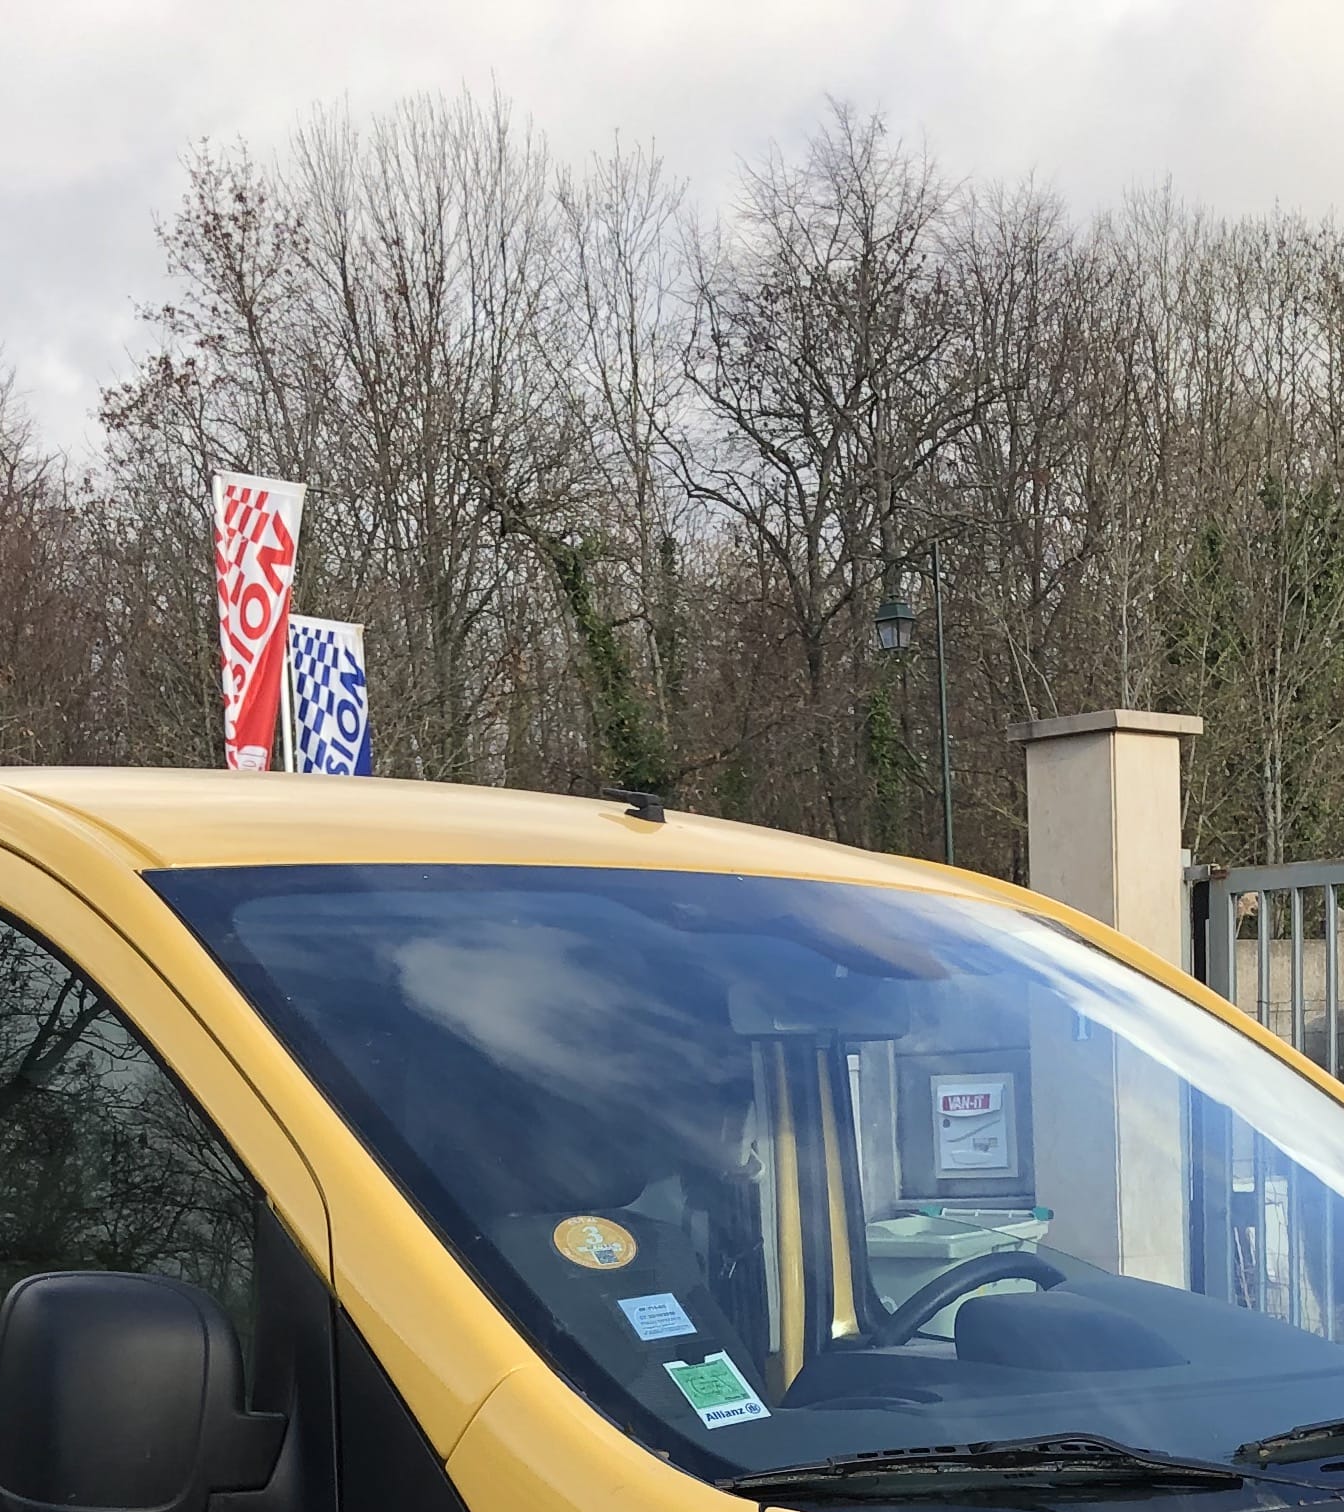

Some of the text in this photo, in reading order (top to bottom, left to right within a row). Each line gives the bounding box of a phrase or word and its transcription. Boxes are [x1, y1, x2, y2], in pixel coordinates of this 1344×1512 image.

[947, 1095, 985, 1111] VAN-IT
[582, 1225, 604, 1245] 3
[704, 1407, 747, 1422] Allianz
